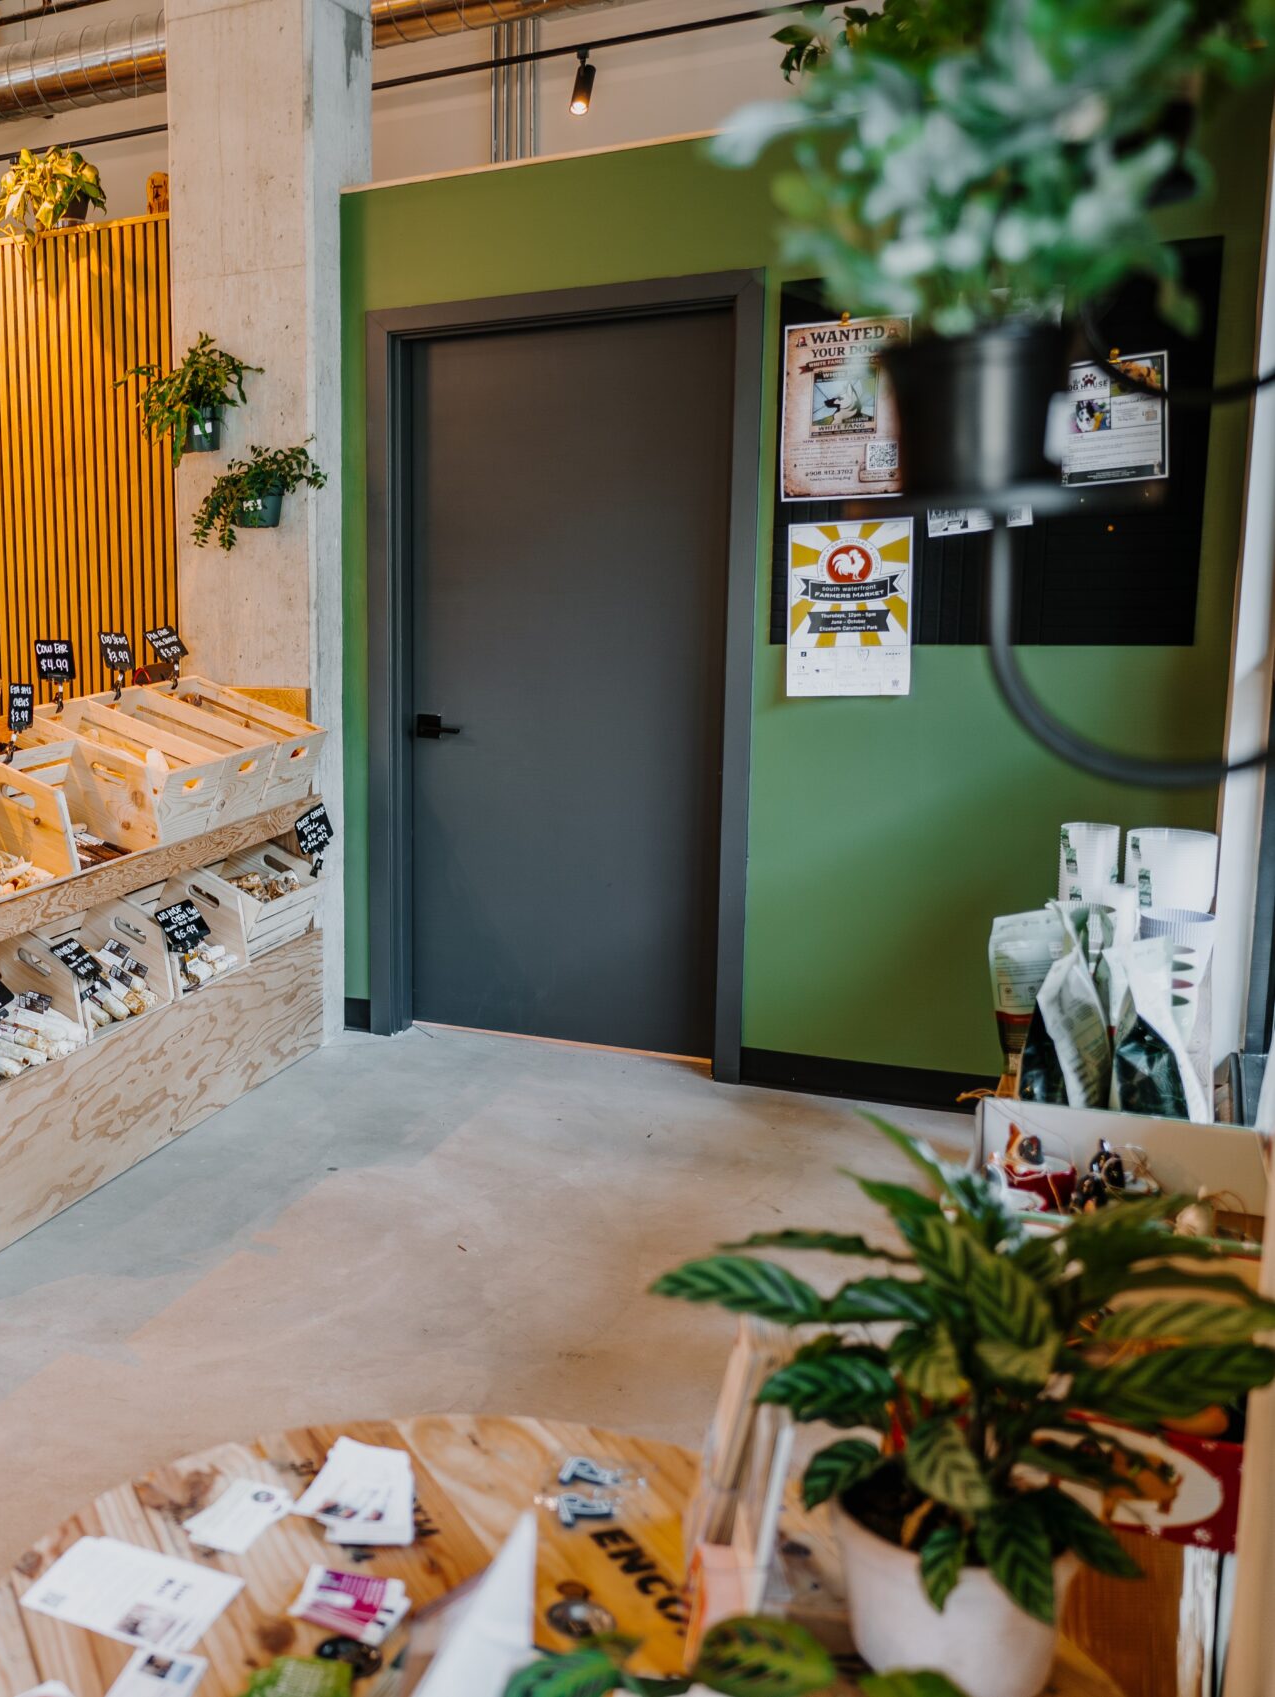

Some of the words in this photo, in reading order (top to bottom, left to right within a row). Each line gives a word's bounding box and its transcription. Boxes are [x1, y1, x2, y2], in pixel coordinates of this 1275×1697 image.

[810, 325, 885, 344] WANTED
[812, 347, 845, 358] YOUR
[852, 589, 884, 598] MARKET
[36, 643, 53, 655] COW
[54, 642, 69, 654] EAR
[107, 647, 130, 664] $3.99
[40, 658, 69, 673] $4.99
[11, 708, 29, 722] $3.99
[296, 815, 311, 831] BEEF
[166, 904, 182, 917] HIDE
[171, 911, 189, 923] CHEW
